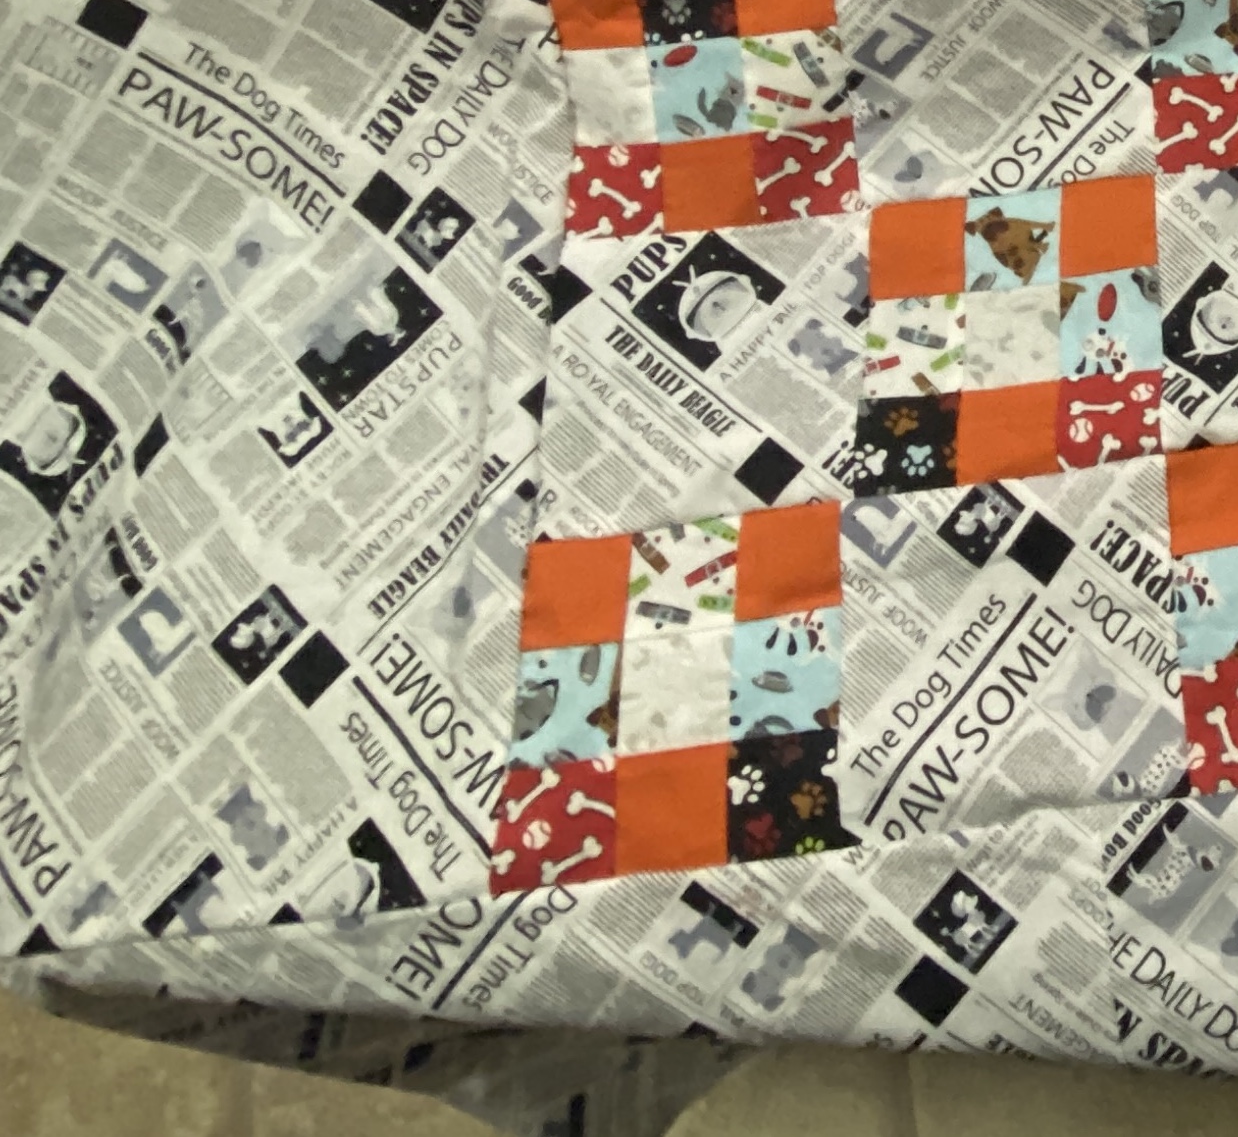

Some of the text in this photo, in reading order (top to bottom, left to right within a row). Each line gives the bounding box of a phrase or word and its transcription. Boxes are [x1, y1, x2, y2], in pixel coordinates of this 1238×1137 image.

[118, 67, 335, 234] PAW-SOME!
[186, 41, 346, 170] The Dog Times
[361, 28, 464, 155] IN SPACE!
[407, 59, 510, 177] DAILY DOG
[610, 234, 689, 304] PUPS
[352, 330, 464, 439] PUPSTAR
[562, 350, 704, 474] ROYAL ENGAGEMENT
[604, 326, 737, 437] THE DAILY BEAGLE
[337, 470, 453, 590] ENGAGEMENT
[368, 542, 440, 619] BEAGLE
[1089, 520, 1187, 612] SPACE!
[851, 592, 1006, 779] The Dog Times
[882, 606, 930, 647] WOOF
[1072, 579, 1184, 698] DAILY DOG
[882, 605, 1075, 842] PAW-SOME!
[341, 713, 462, 882] The Dog Times
[514, 886, 577, 939] Dog
[1131, 947, 1203, 1022] DAILY
